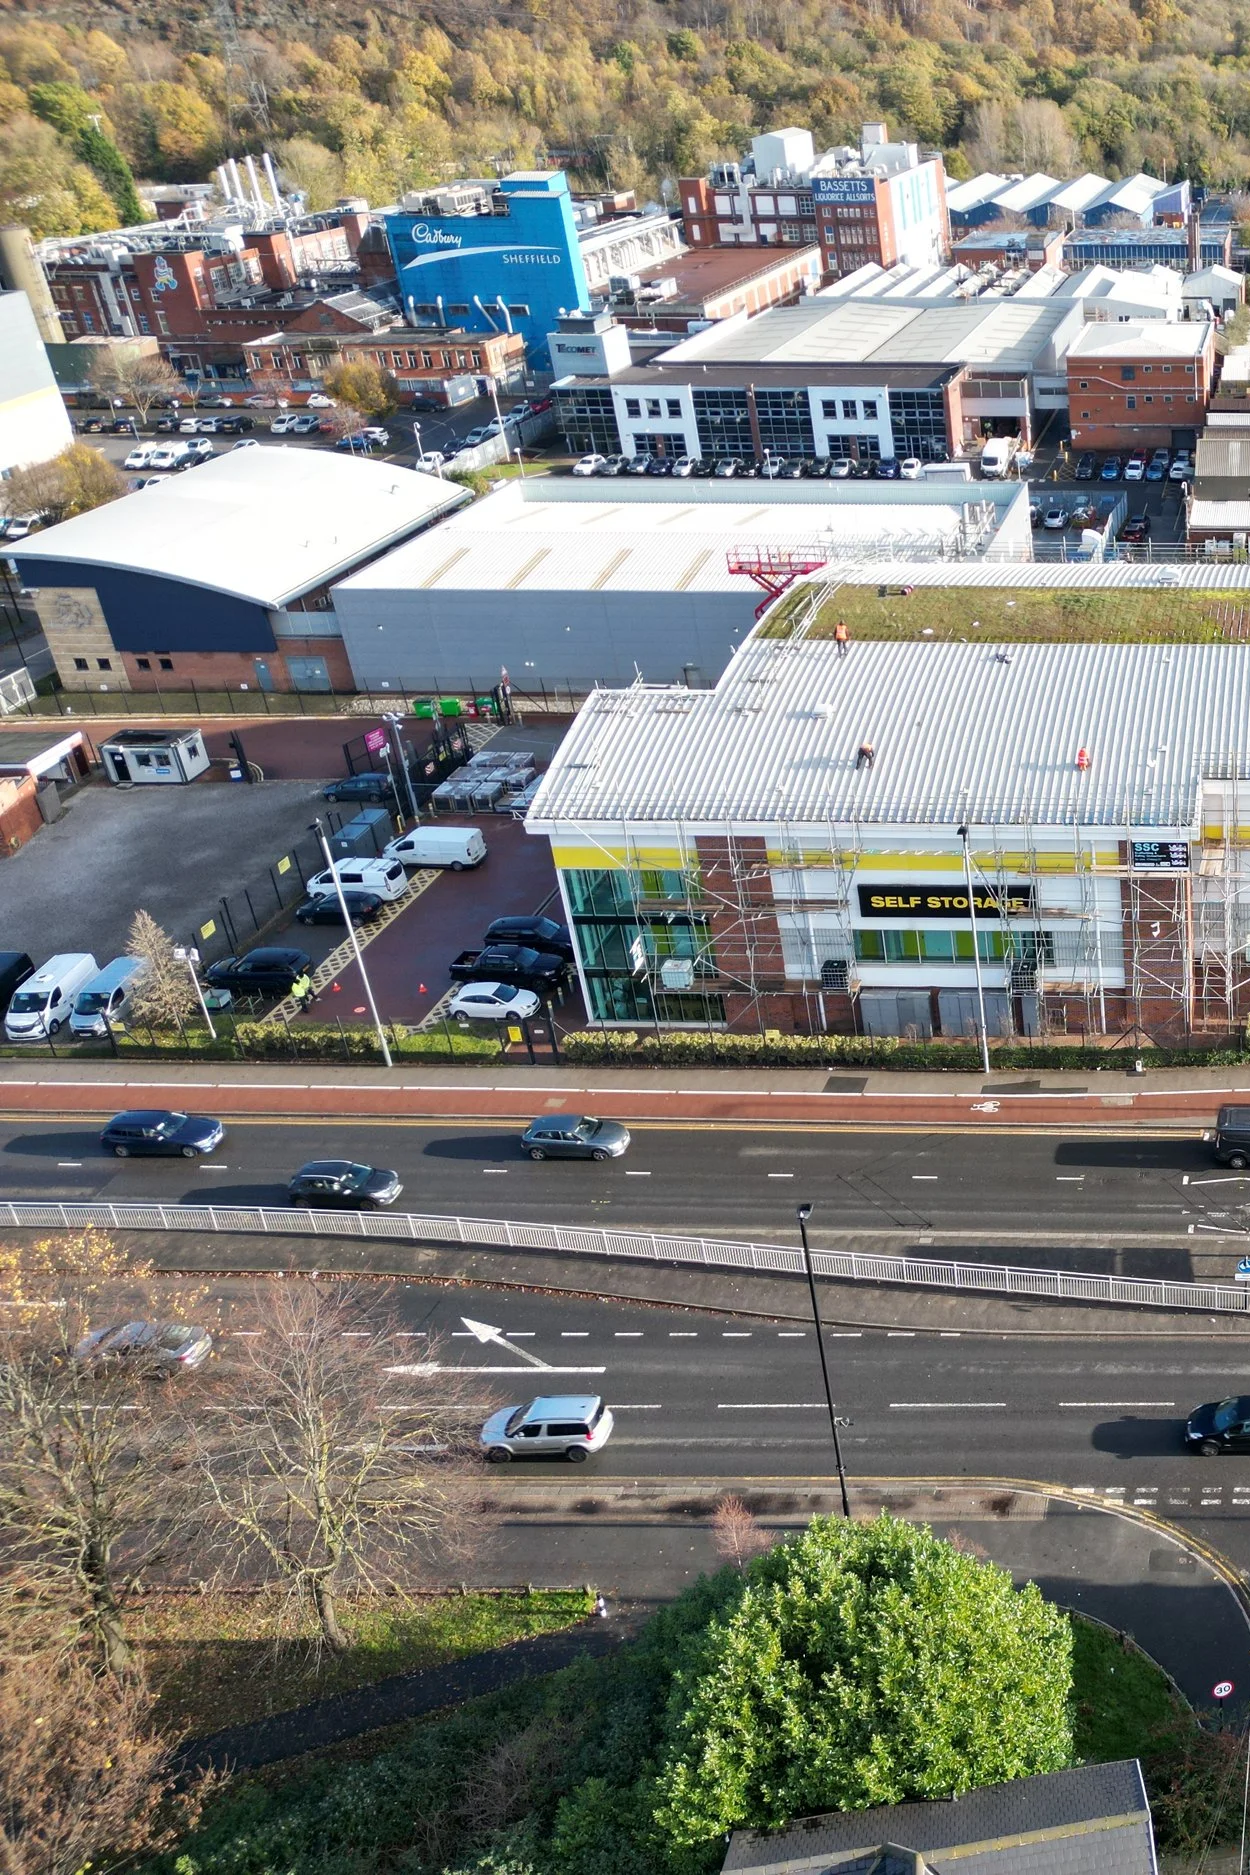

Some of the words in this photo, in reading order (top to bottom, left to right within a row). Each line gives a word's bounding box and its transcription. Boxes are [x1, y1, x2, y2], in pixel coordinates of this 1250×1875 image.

[820, 180, 868, 192] BASSETTS
[815, 192, 846, 202] LIQUORICE
[846, 192, 876, 201] ALLSORTS
[411, 222, 462, 248] Cadbury
[502, 254, 561, 264] SHEFFIELD
[1135, 843, 1159, 851] SSC
[870, 895, 922, 908] SELF
[1216, 1684, 1231, 1695] 30
